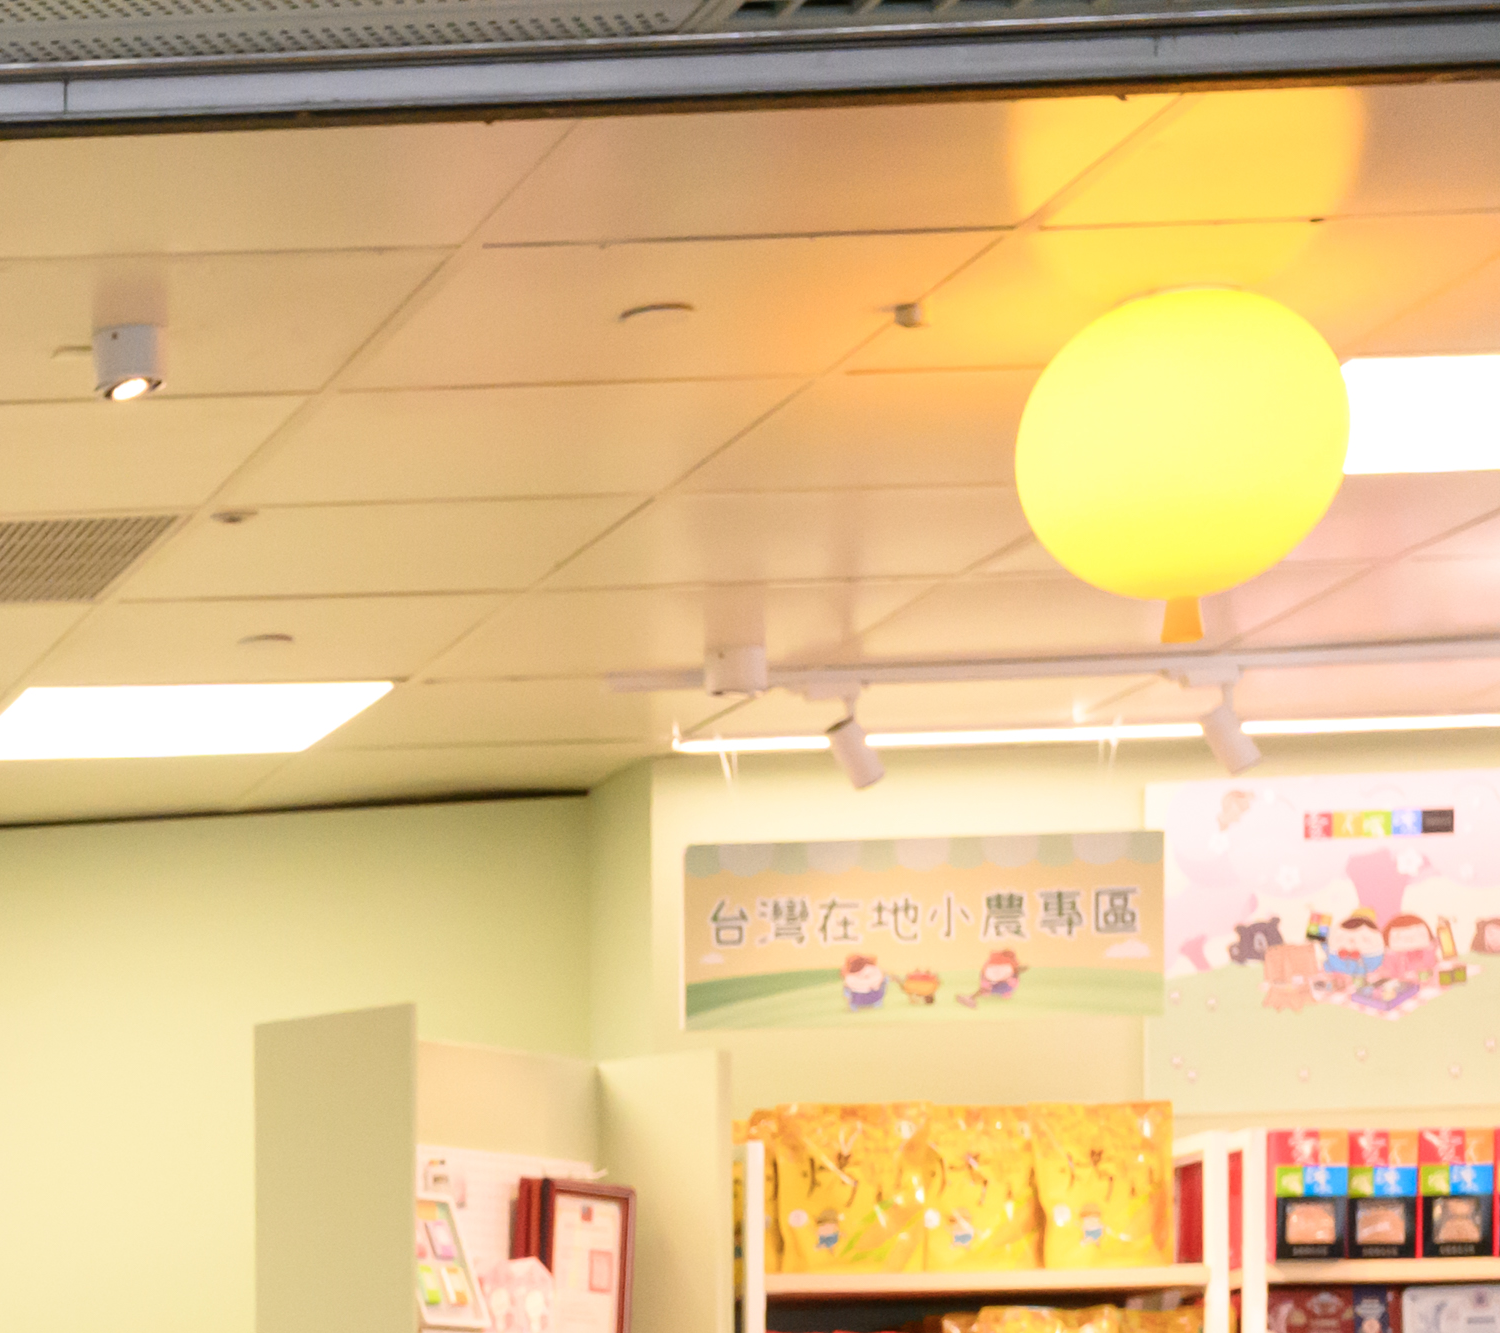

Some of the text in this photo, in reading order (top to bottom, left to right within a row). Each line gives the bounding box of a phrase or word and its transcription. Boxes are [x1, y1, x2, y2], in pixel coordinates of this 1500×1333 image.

[709, 885, 1141, 947] 台灣在地小農專區
